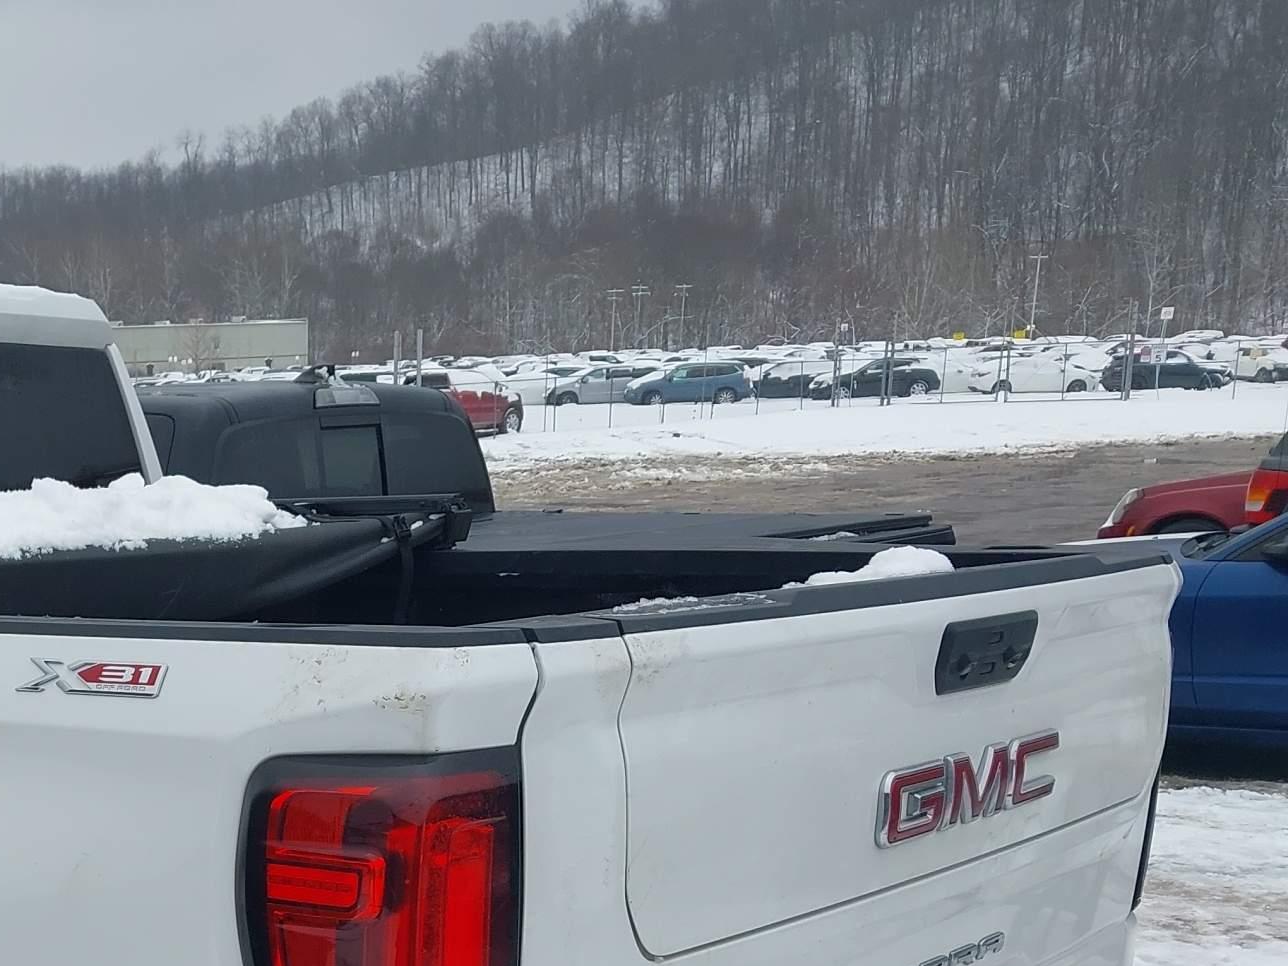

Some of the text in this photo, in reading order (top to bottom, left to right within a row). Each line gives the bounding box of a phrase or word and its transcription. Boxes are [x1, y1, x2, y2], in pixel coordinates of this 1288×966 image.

[95, 683, 147, 692] OFF ROAD
[874, 727, 1061, 849] GMC
